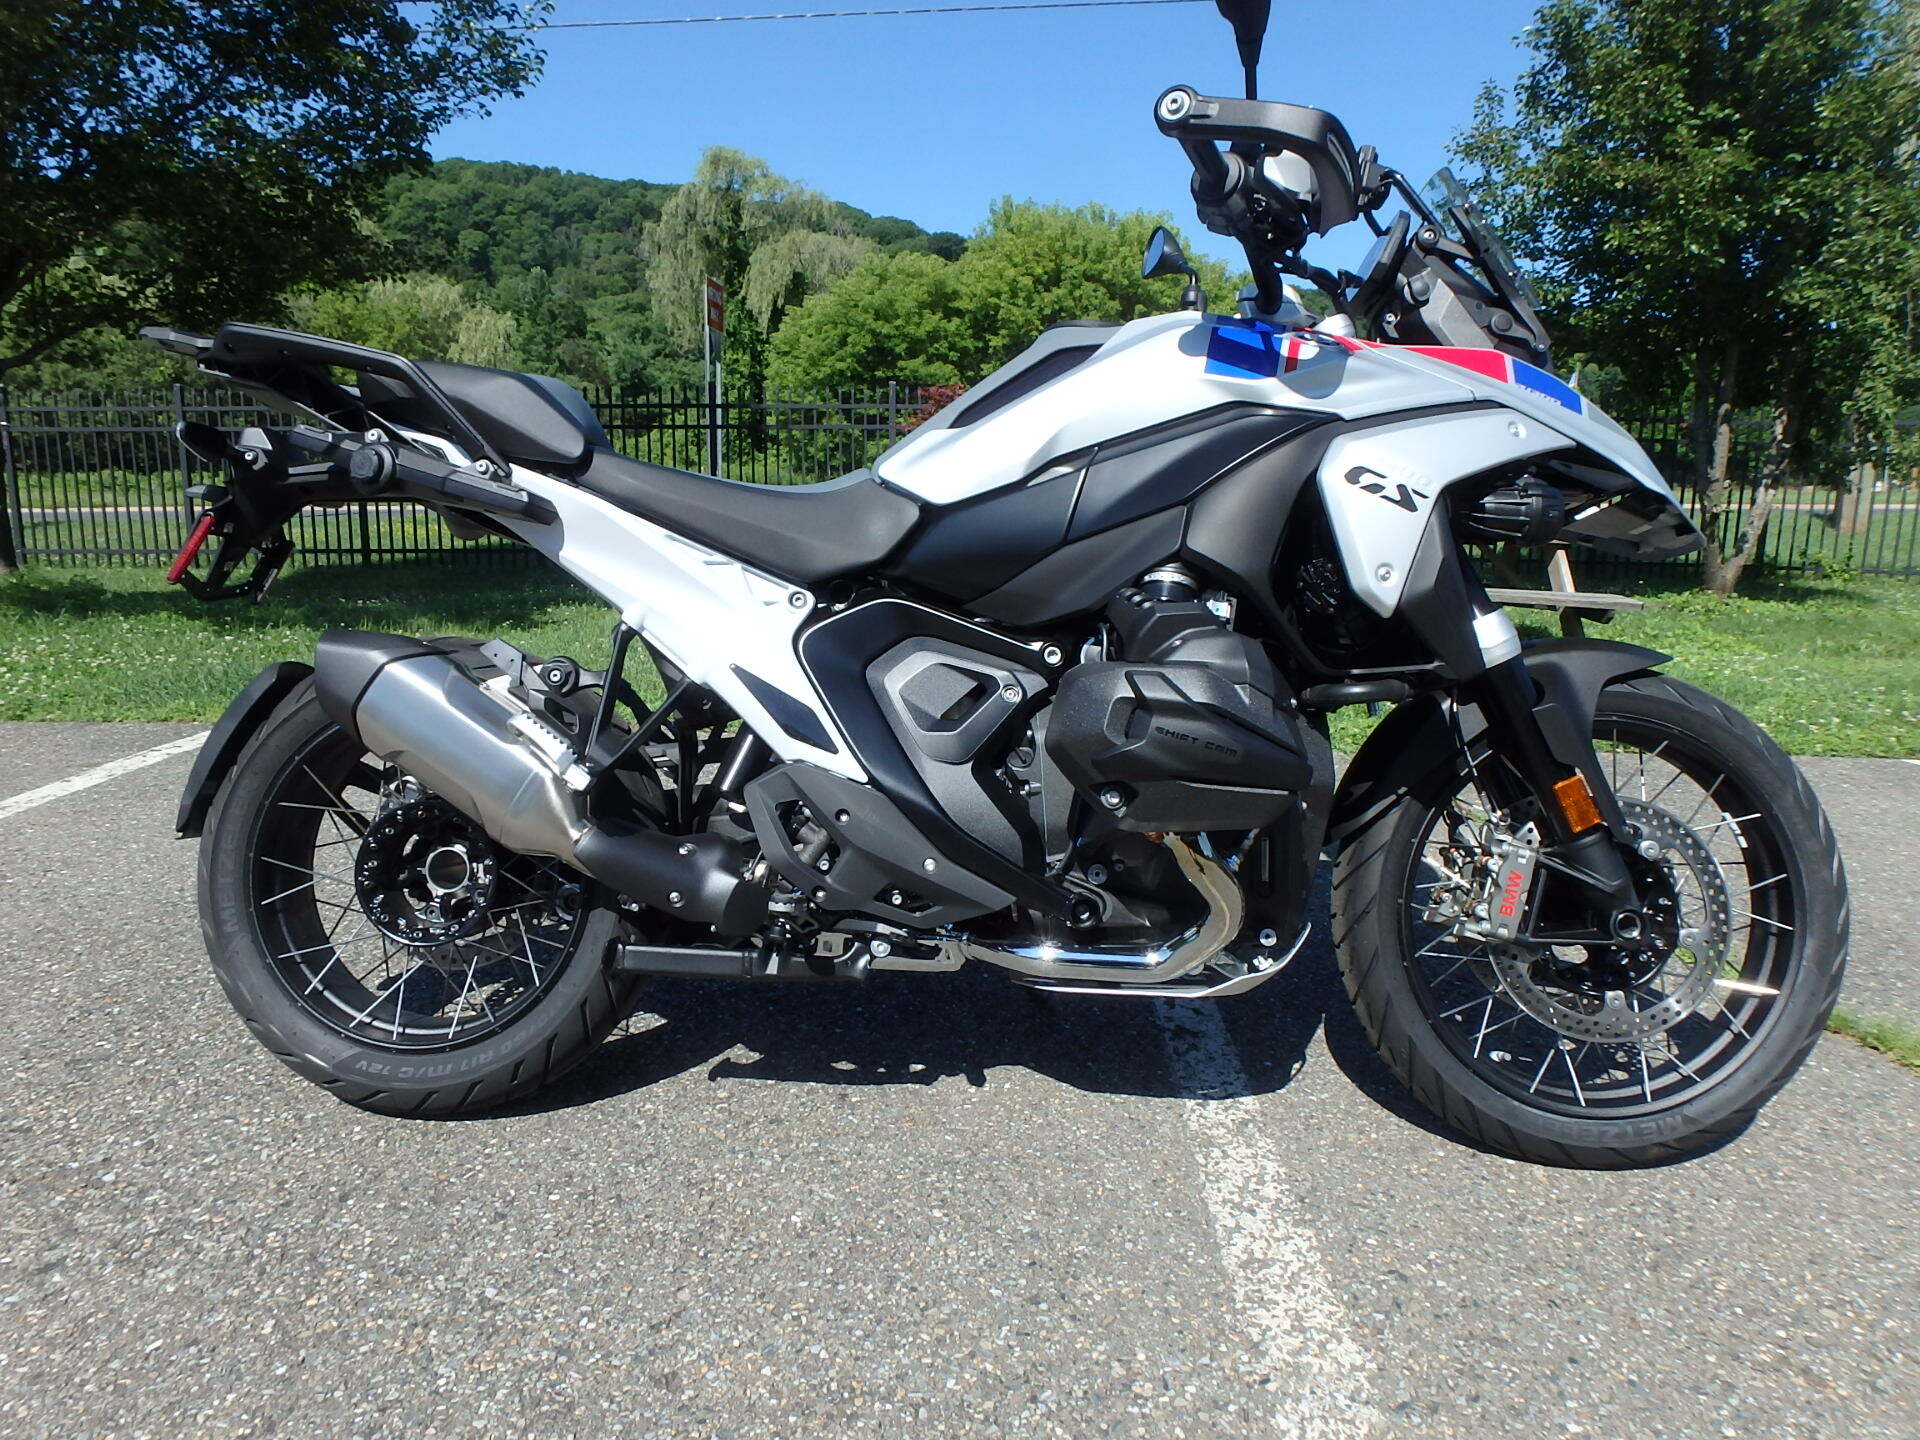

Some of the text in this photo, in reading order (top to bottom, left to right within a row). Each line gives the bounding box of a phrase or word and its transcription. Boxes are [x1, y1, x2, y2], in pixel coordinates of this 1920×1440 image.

[1344, 466, 1430, 513] GS
[1155, 726, 1238, 758] SHIFT CAM
[1499, 869, 1525, 917] BMW
[397, 1062, 453, 1079] M/C
